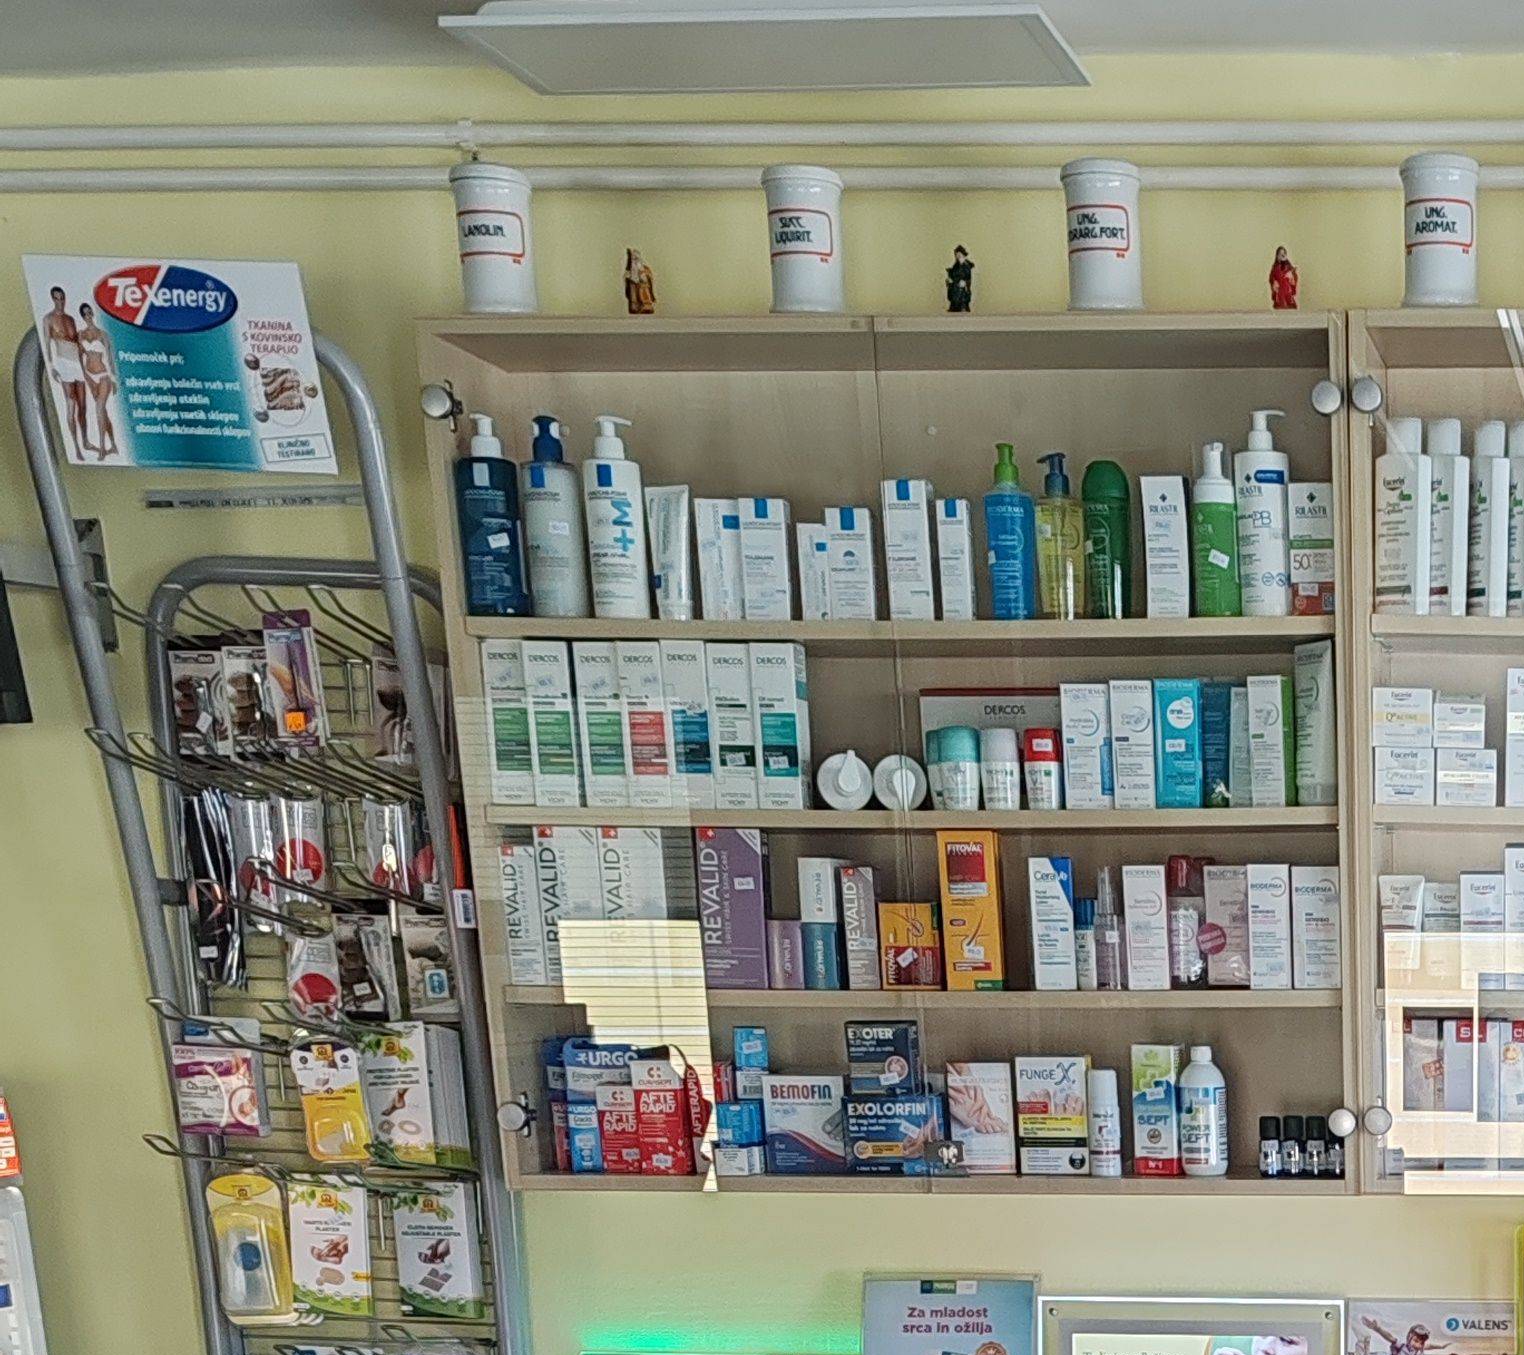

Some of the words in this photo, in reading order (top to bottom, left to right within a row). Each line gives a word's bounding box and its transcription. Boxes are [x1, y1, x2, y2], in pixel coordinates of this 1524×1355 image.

[107, 276, 227, 313] Texenergy
[984, 704, 1026, 716] DERCOS
[947, 843, 982, 856] FITOVAL
[542, 846, 558, 941] REVALID
[704, 846, 722, 946] REVALID
[507, 862, 520, 940] REVALID
[848, 1027, 893, 1040] EXOTER
[640, 1092, 674, 1104] AFTE
[770, 1084, 832, 1100] BEMOFIN
[640, 1103, 675, 1114] RAPID
[848, 1102, 926, 1116] EXOLORFIN
[604, 1112, 637, 1123] AFTE
[1137, 1114, 1169, 1126] SEPT
[603, 1122, 637, 1132] RAPID
[907, 1306, 926, 1318] Za
[930, 1306, 988, 1318] mladost
[902, 1323, 932, 1334] srca
[937, 1322, 950, 1333] in
[954, 1321, 993, 1335] ožilja
[1461, 1319, 1509, 1331] VALENS
